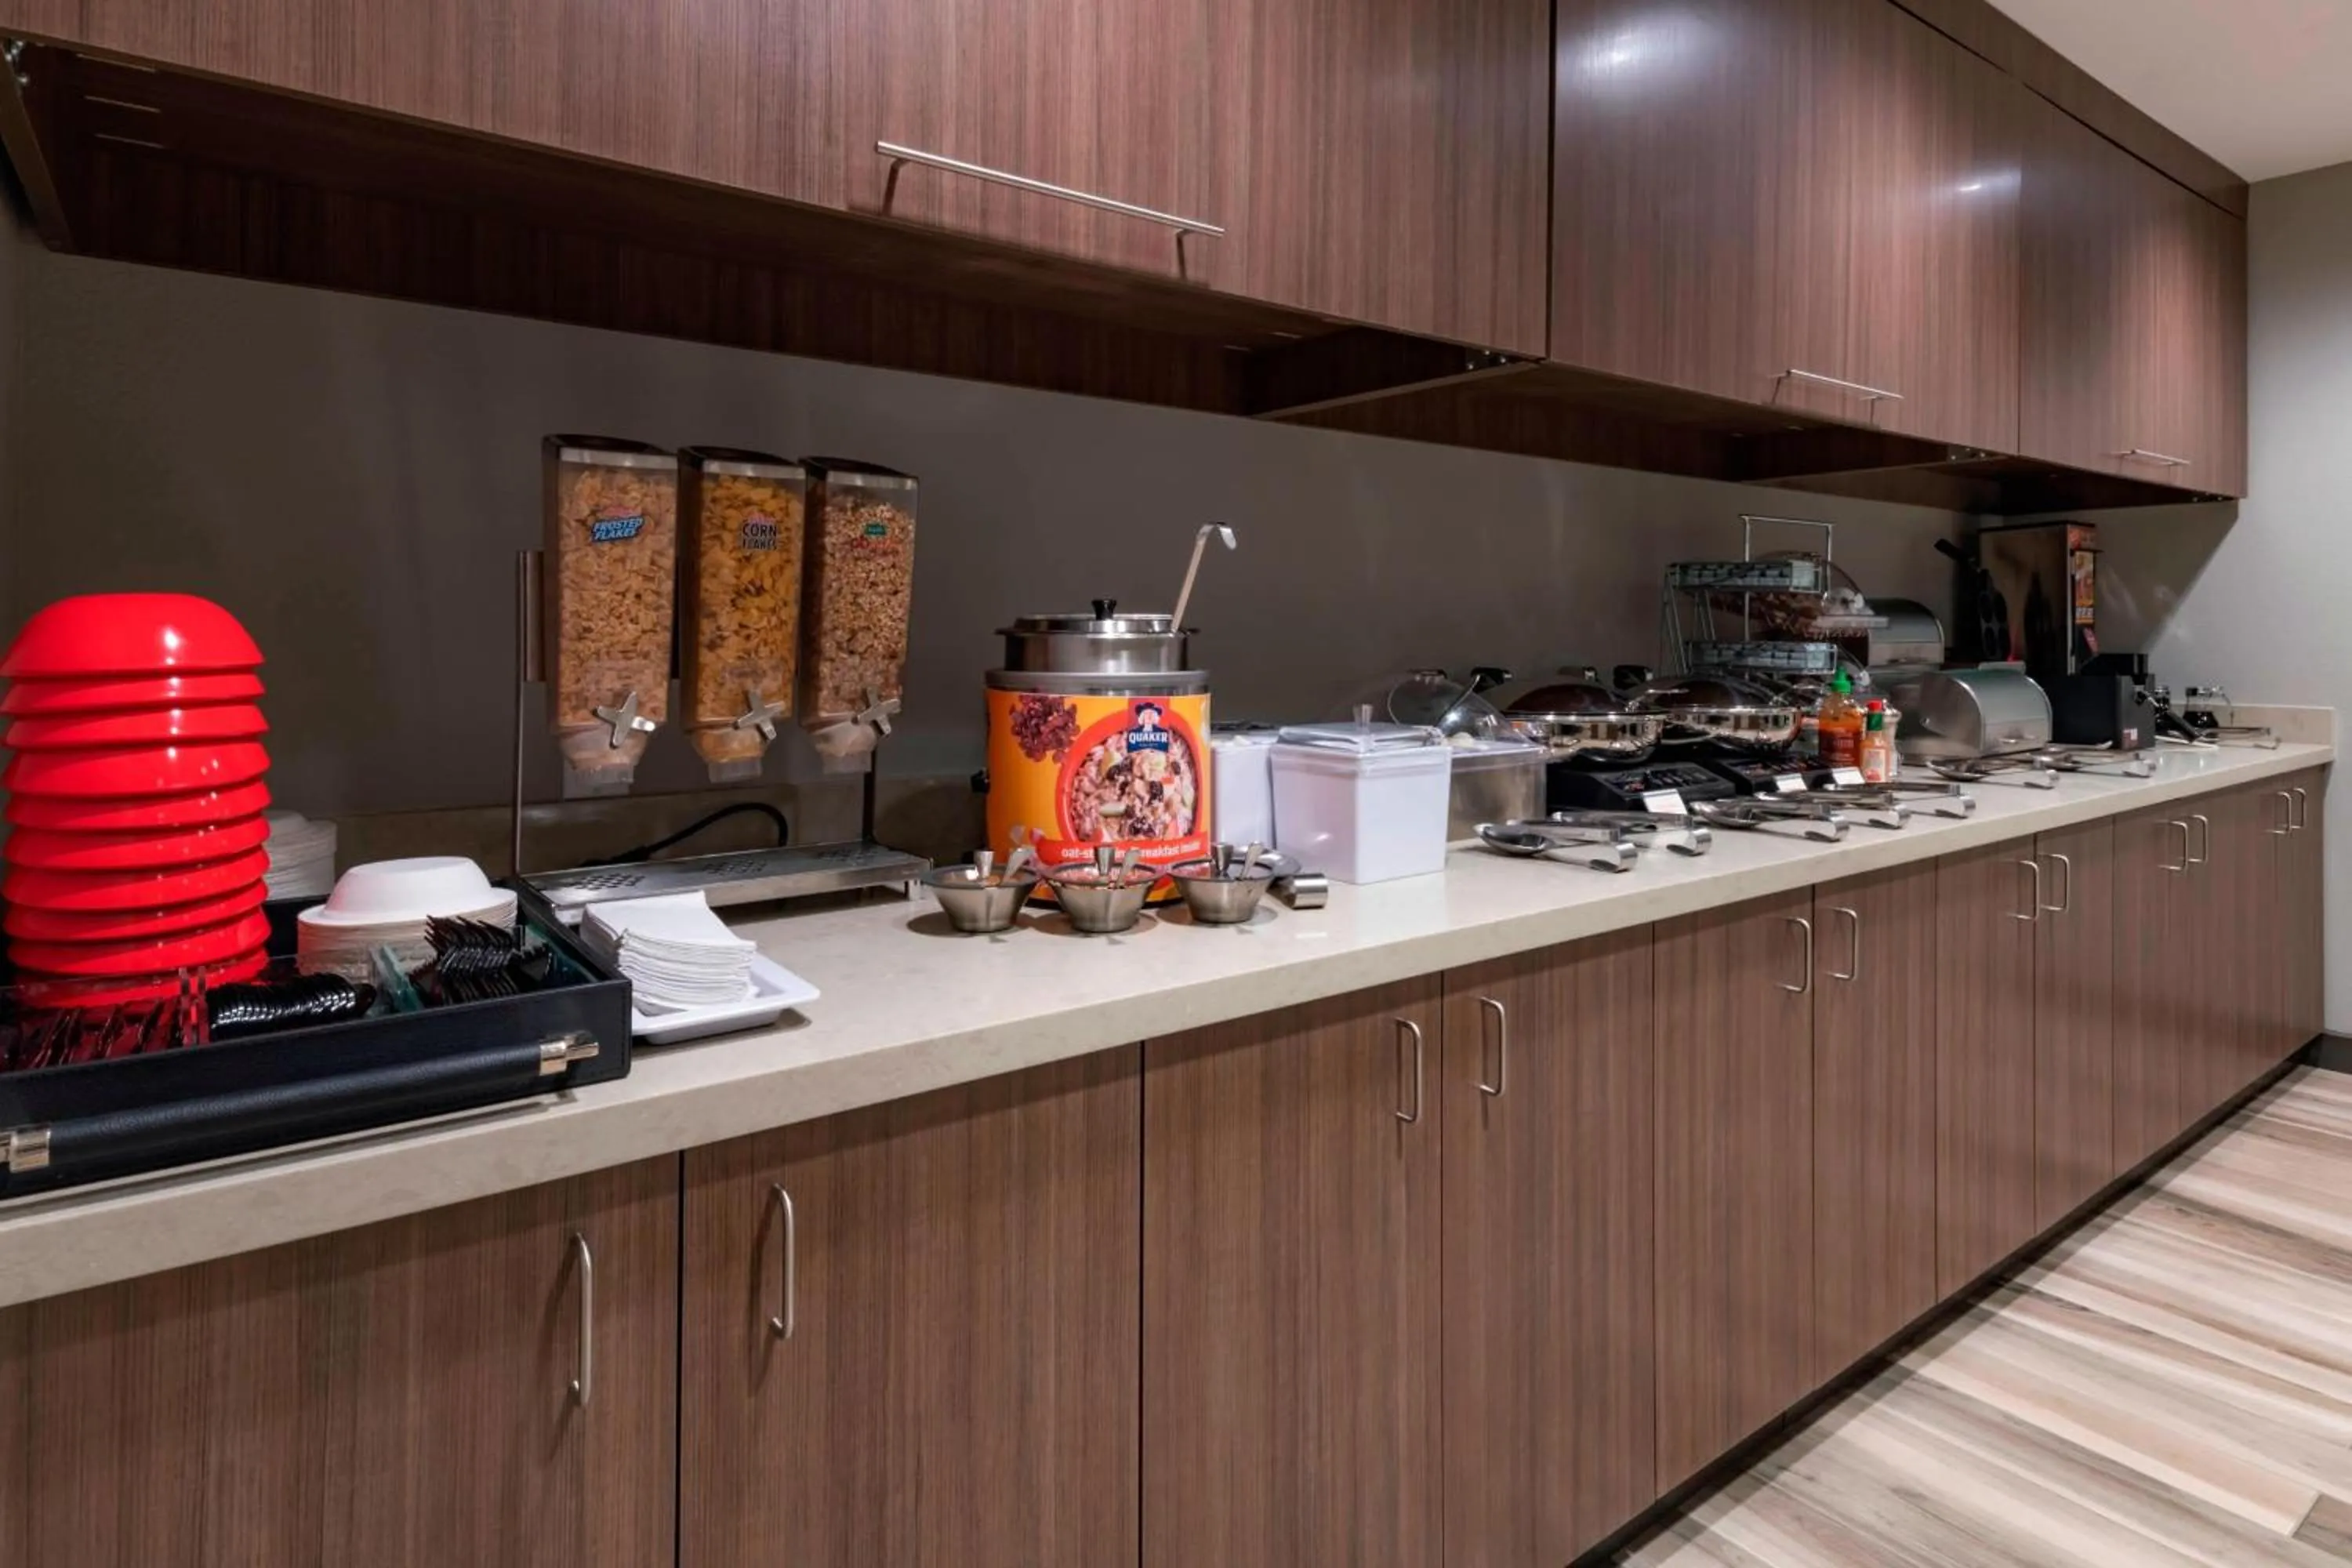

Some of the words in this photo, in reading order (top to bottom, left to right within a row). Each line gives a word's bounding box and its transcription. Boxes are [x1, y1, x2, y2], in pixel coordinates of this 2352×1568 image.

[593, 517, 643, 532] FROSTED
[742, 523, 777, 538] CORN
[1128, 731, 1168, 745] QUAKER
